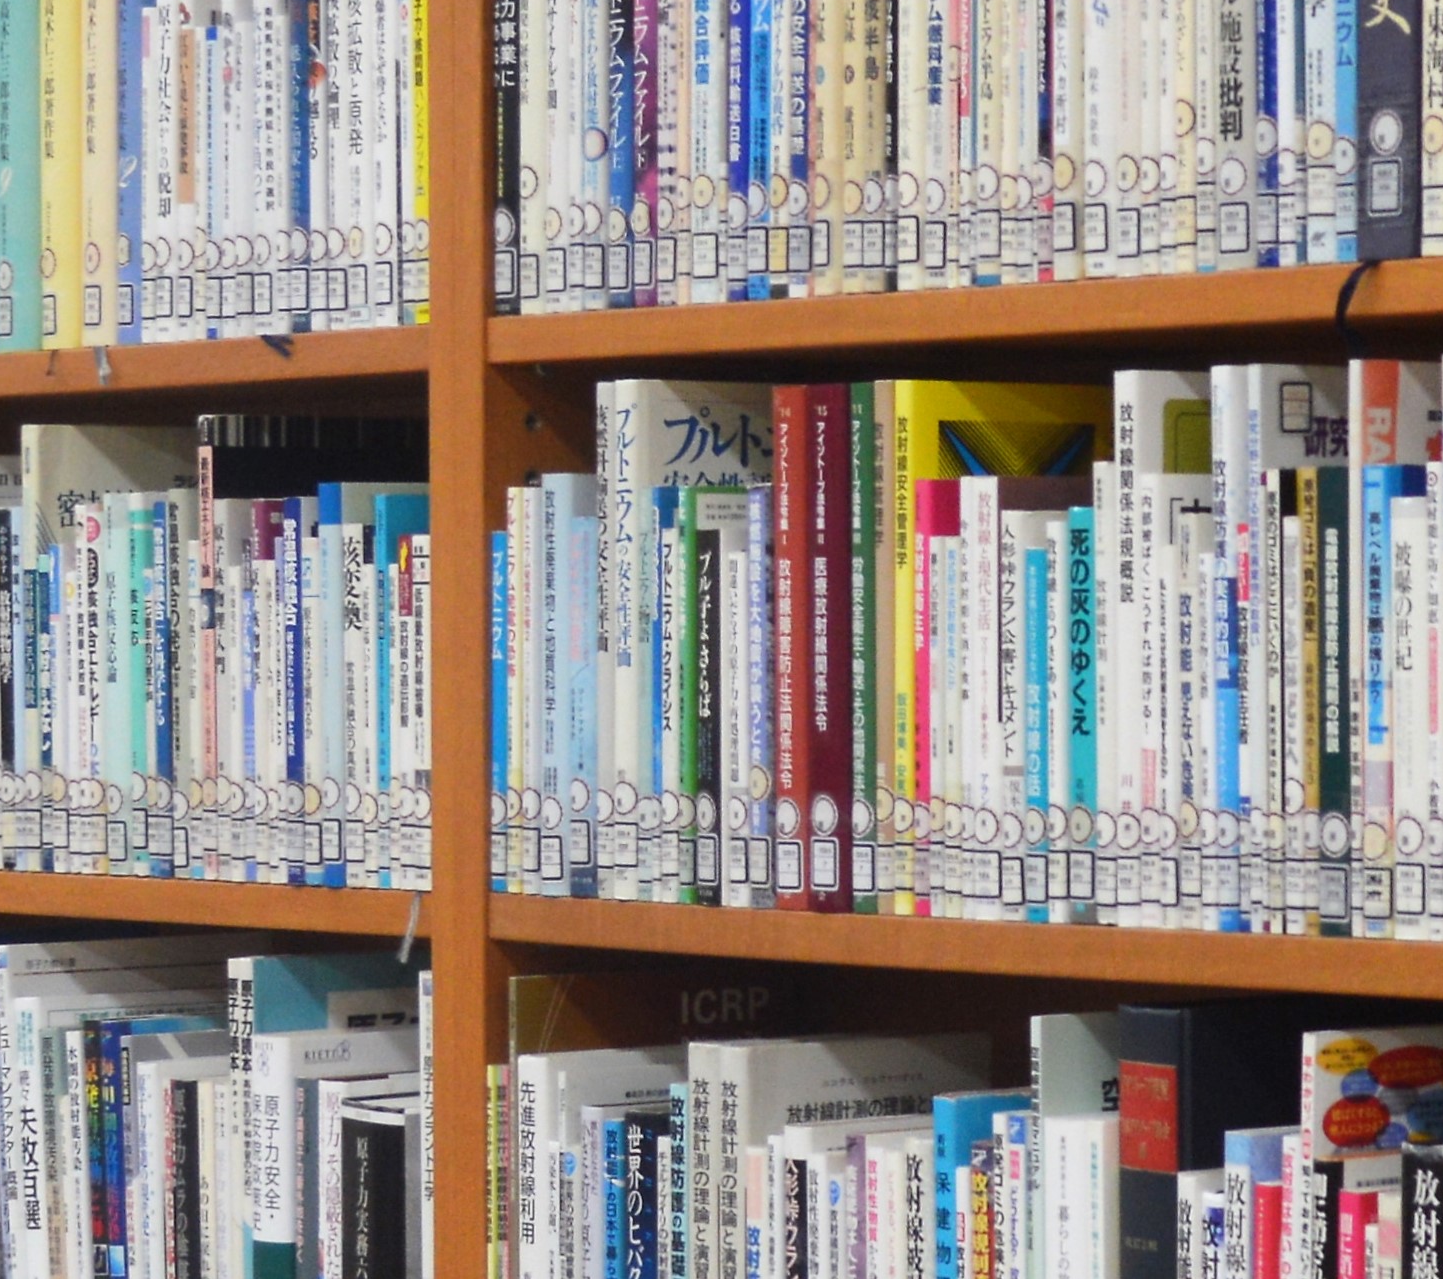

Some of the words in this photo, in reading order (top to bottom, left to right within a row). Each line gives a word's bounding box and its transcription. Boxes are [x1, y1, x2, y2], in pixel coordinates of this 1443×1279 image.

[1120, 403, 1134, 603] 放射線関係法規概説
[1070, 527, 1091, 738] 死の灰のゆくえ
[19, 1108, 41, 1231] 失敗百選
[520, 1082, 535, 1245] 先進放射線利用
